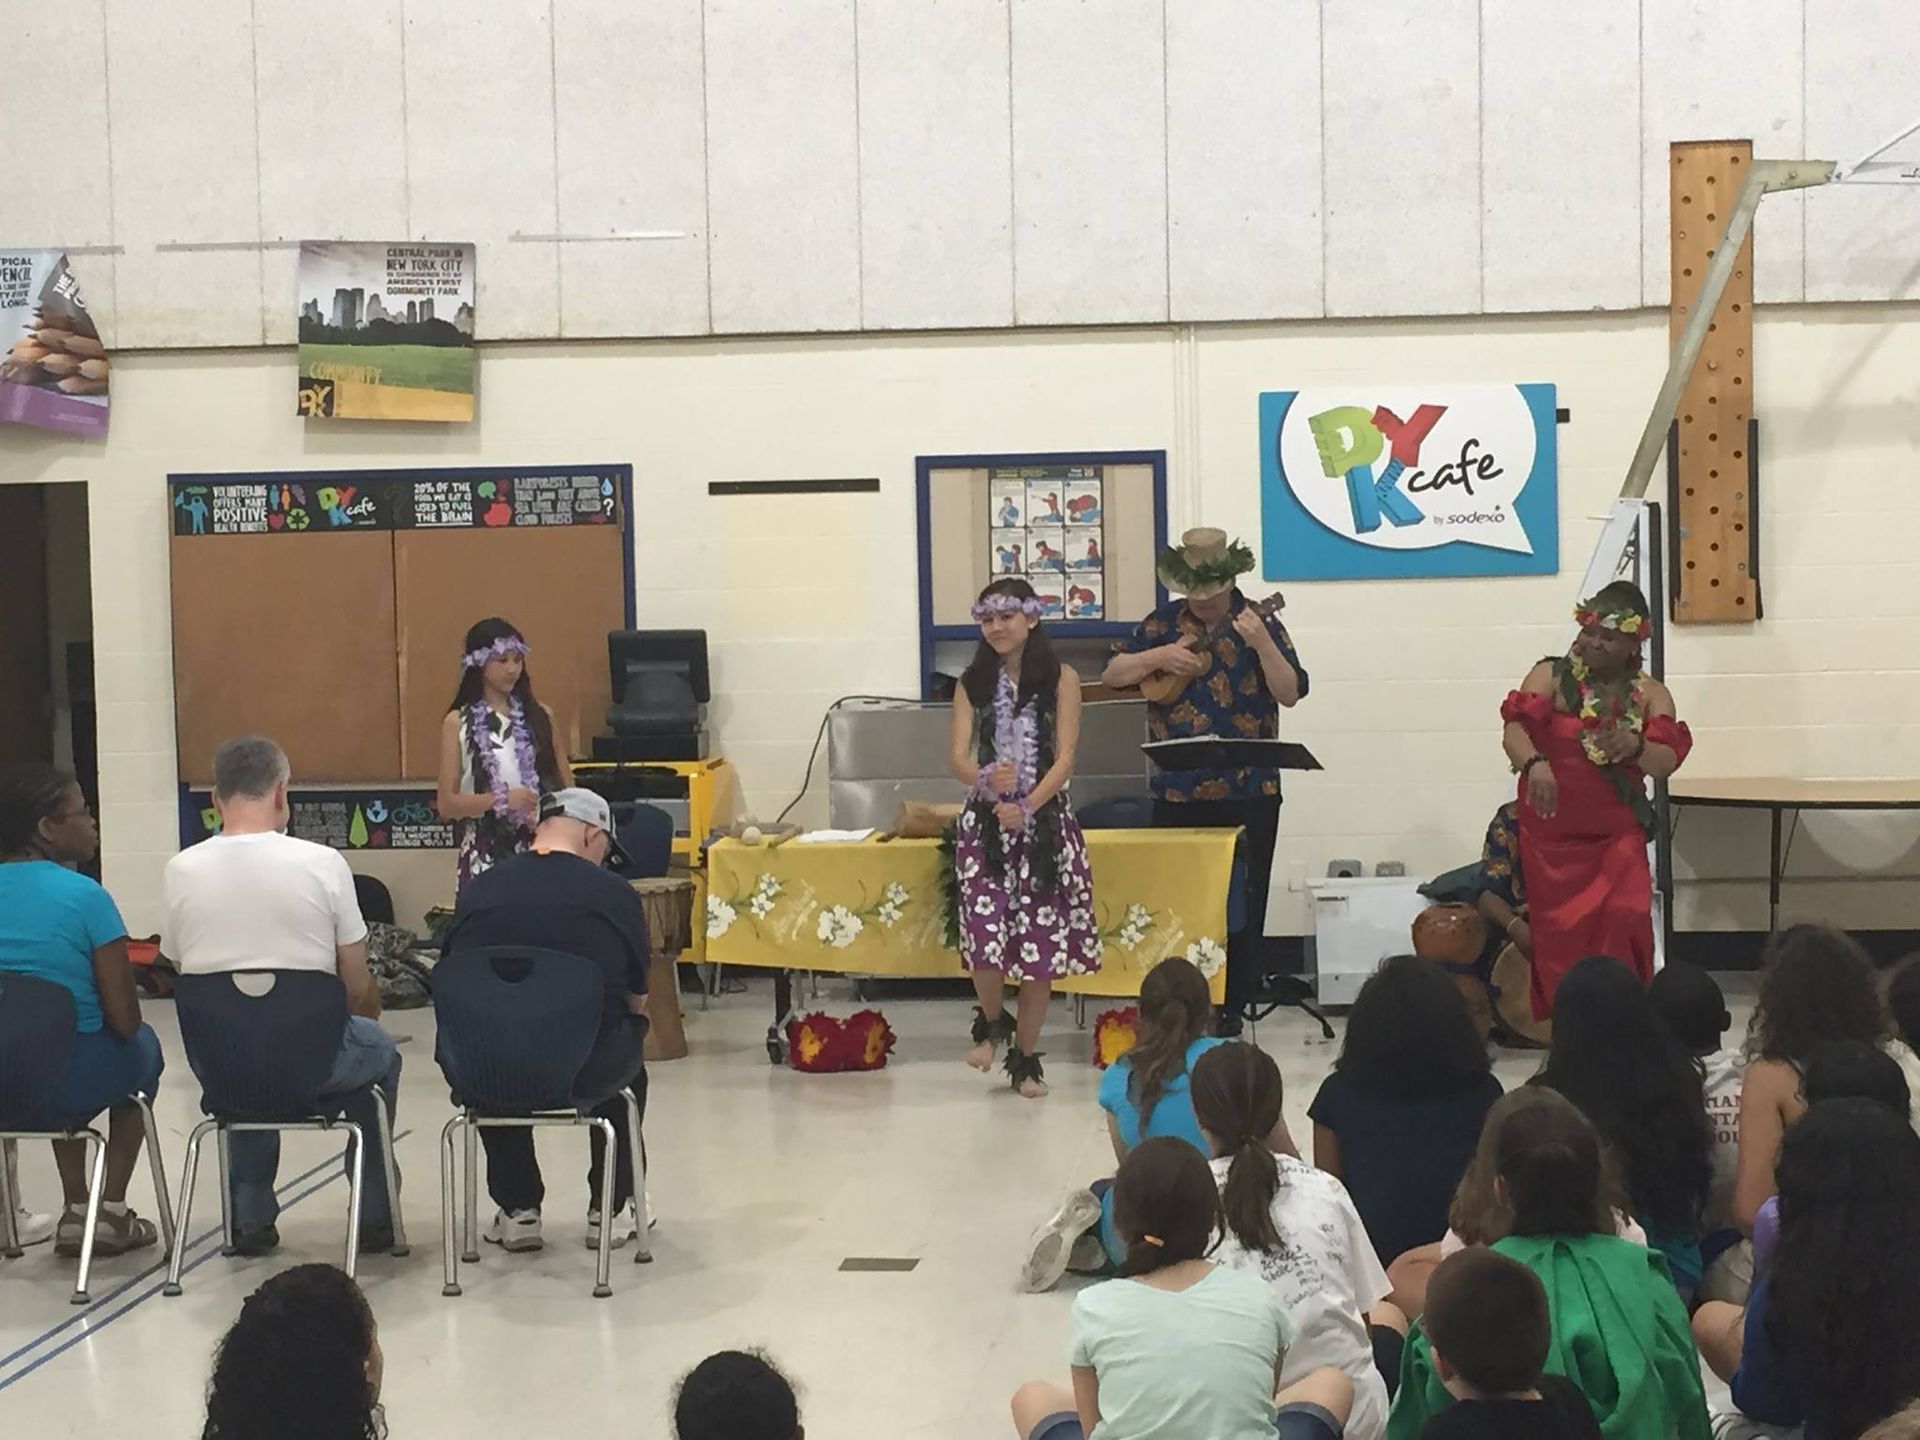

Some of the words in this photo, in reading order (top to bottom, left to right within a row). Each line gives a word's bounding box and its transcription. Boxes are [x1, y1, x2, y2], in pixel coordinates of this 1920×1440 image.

[387, 248, 425, 257] CENTRAL
[0, 257, 33, 266] PICAL
[387, 259, 407, 270] NEW
[411, 259, 437, 270] YORK
[441, 260, 462, 271] CITY
[387, 287, 435, 296] COMMUNITY
[438, 287, 460, 296] PARK
[1407, 438, 1504, 495] cafe
[414, 482, 435, 494] 20%
[436, 481, 450, 493] OF
[451, 481, 471, 493] THE
[345, 496, 377, 516] cafe
[439, 501, 451, 511] TO
[213, 507, 268, 522] POSITIVE
[415, 512, 437, 523] THE
[440, 510, 473, 523] BRAIN
[1433, 515, 1445, 526] by
